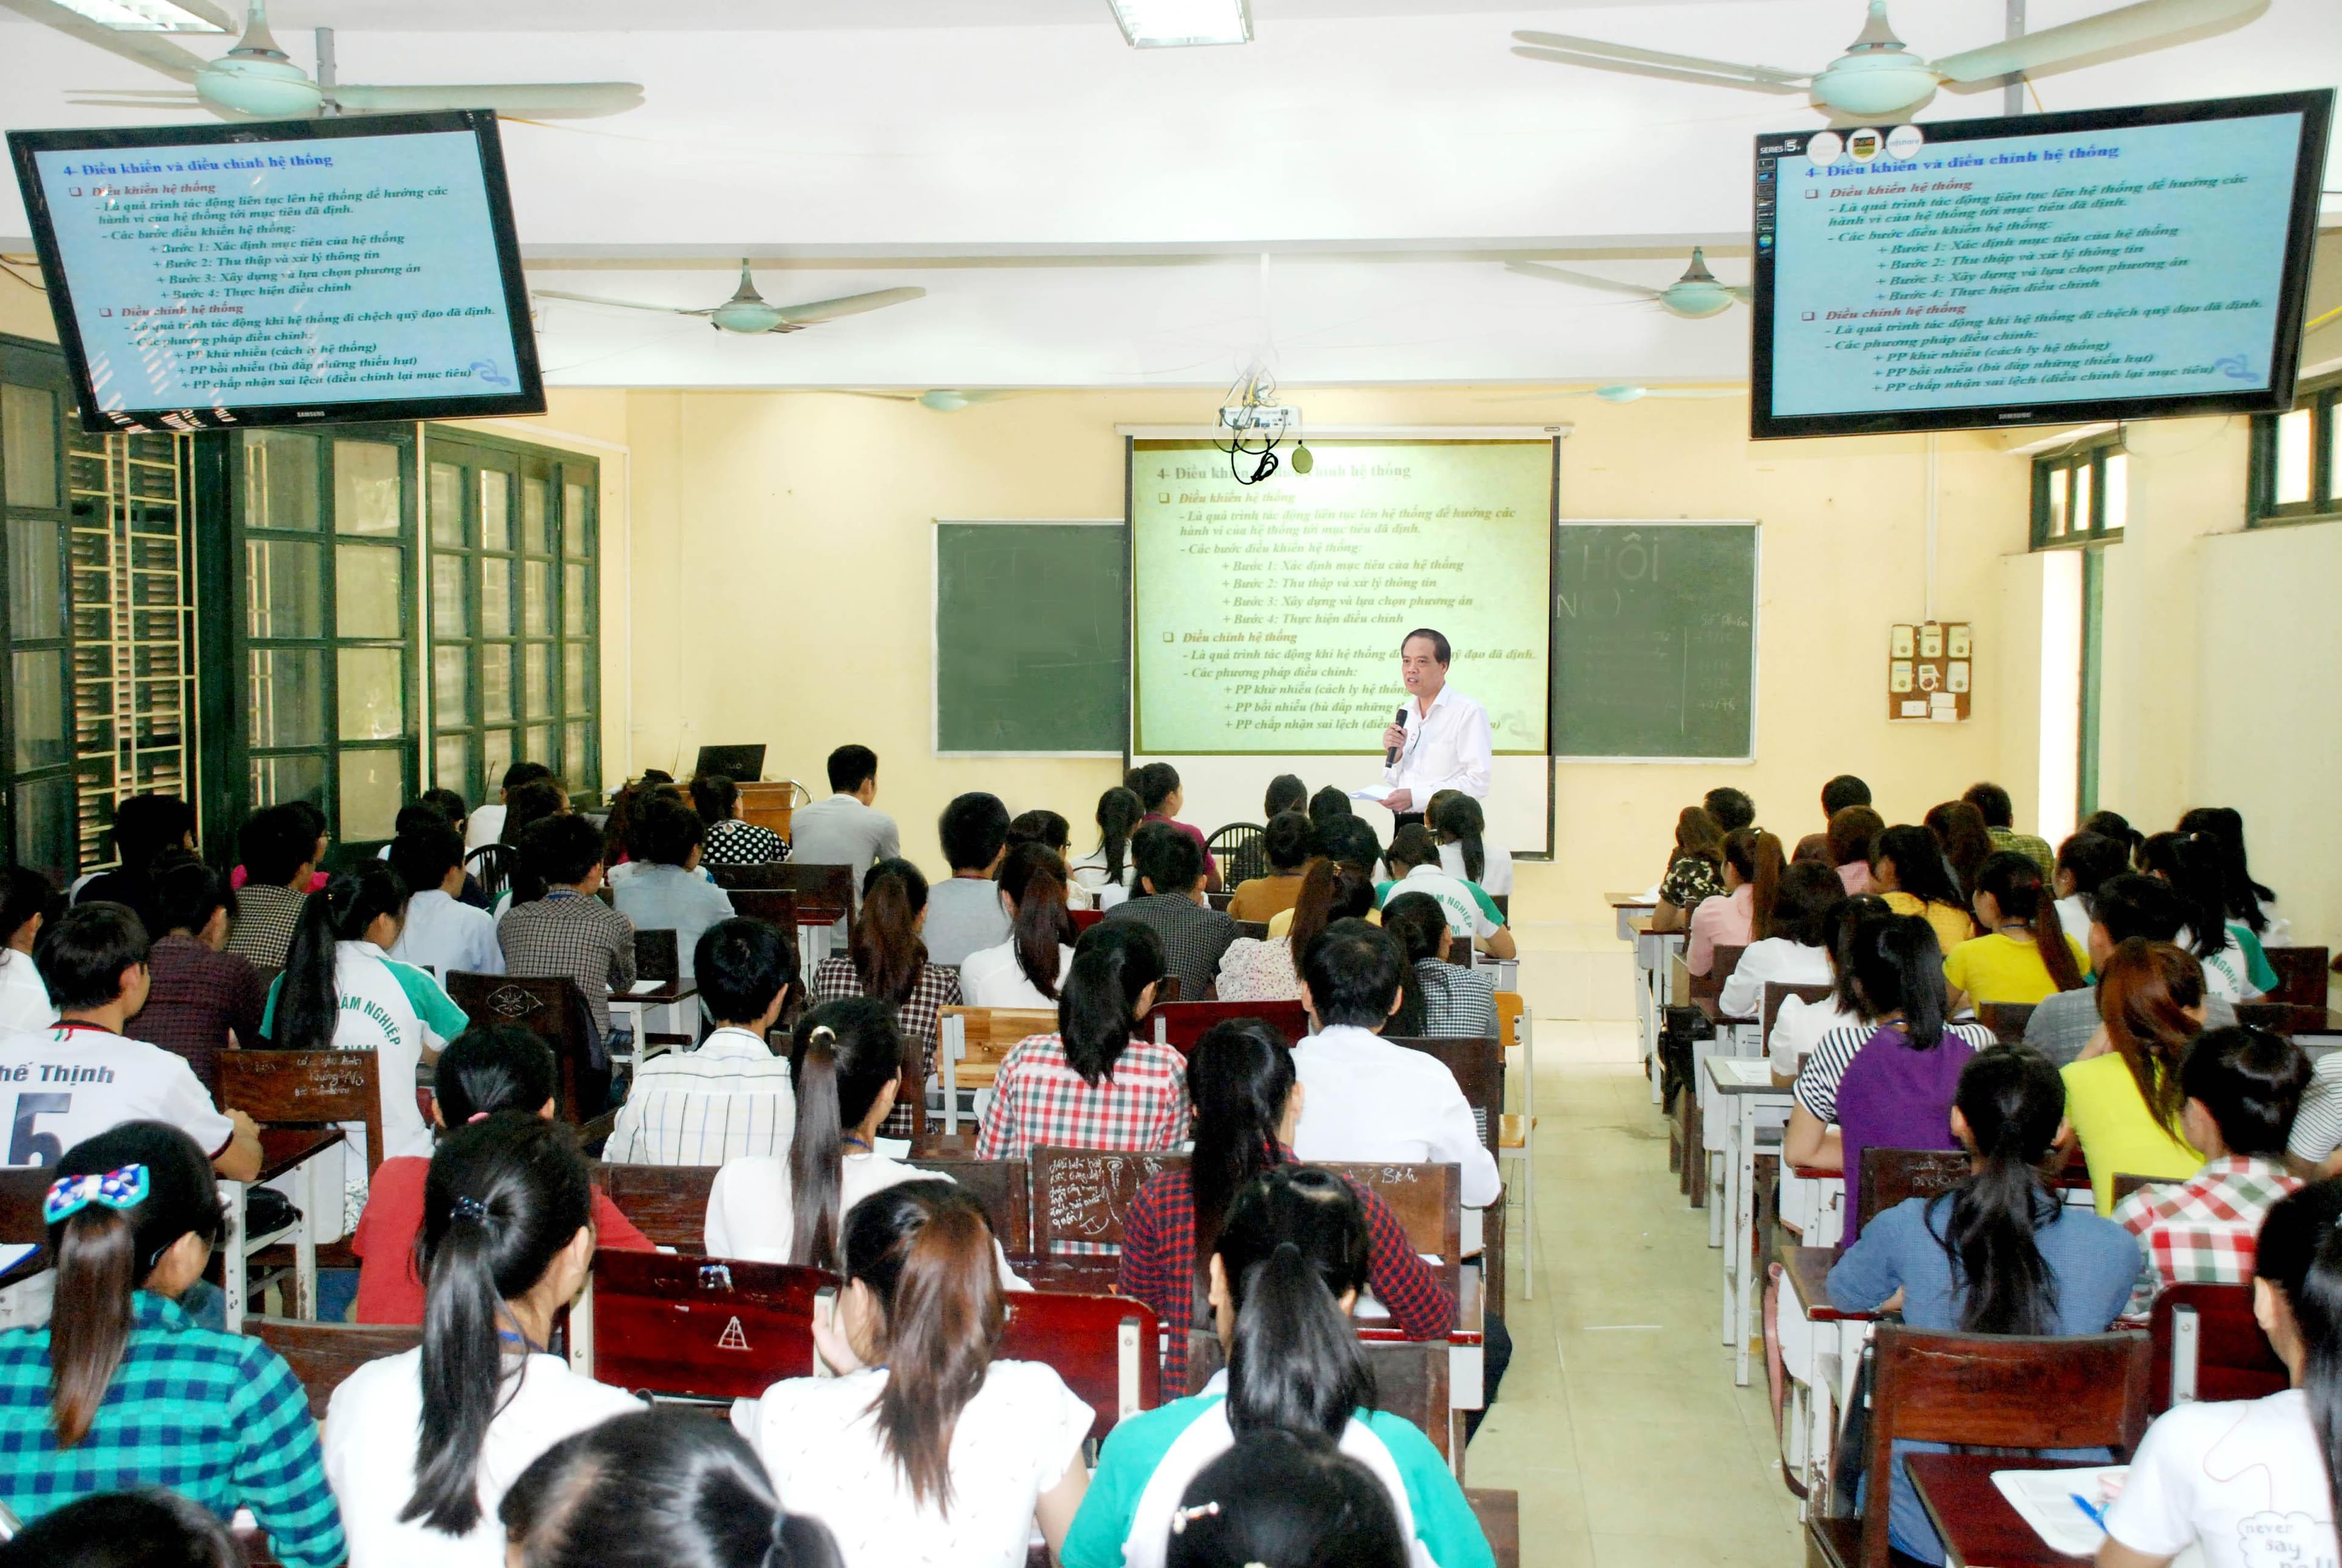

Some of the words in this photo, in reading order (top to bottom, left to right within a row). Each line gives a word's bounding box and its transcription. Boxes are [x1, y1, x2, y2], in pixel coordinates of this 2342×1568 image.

[63, 165, 78, 176] 4-
[132, 214, 144, 223] vi
[201, 257, 212, 267] 2:
[216, 257, 242, 266] Thu
[363, 250, 380, 259] tin
[207, 288, 220, 298] 4:
[1267, 596, 1277, 606] 3:
[1267, 615, 1278, 624] 4:
[1315, 650, 1333, 658] khi
[1235, 685, 1252, 693] PP
[1349, 684, 1358, 696] ly
[1236, 720, 1252, 729] PP
[340, 993, 362, 1011] ÂM
[363, 1000, 401, 1045] NGHIỆP
[41, 1064, 116, 1086] Thịnh
[2246, 1524, 2293, 1534] never
[2265, 1540, 2300, 1559] say
